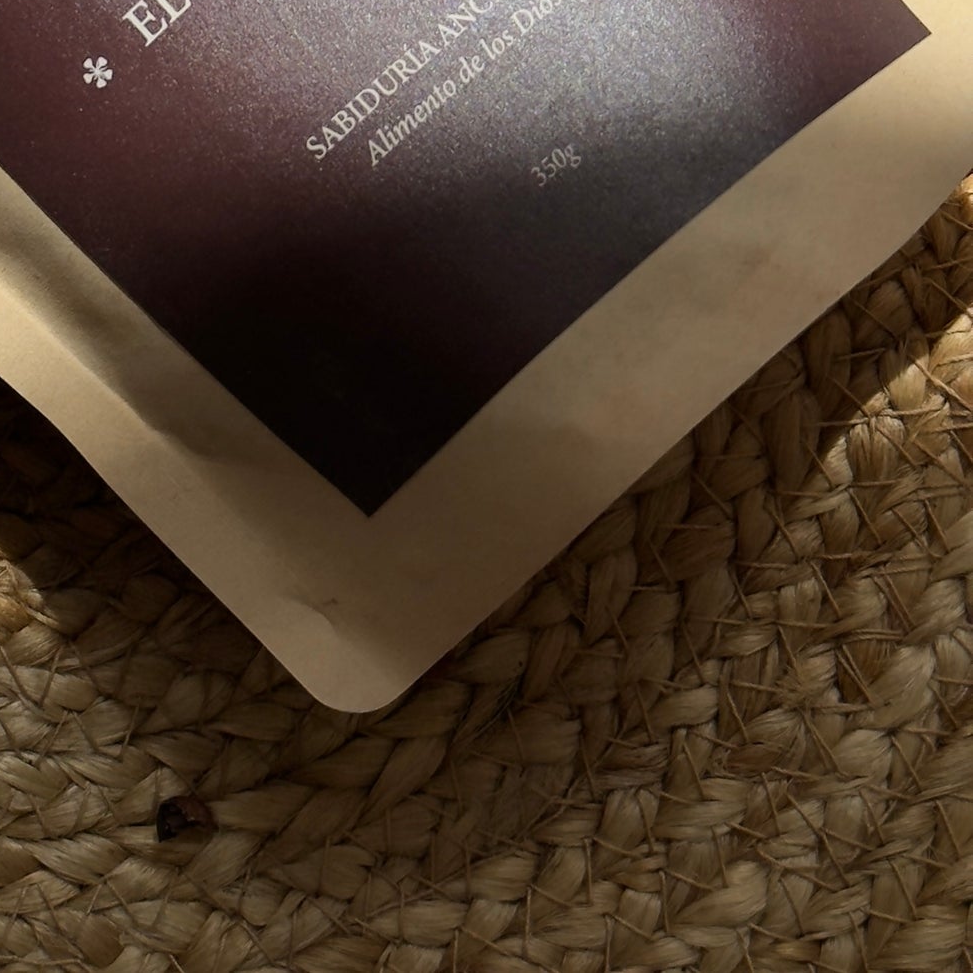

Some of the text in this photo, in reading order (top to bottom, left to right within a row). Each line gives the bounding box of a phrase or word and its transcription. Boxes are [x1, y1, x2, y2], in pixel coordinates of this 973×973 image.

[306, 37, 442, 160] SABIDURÍA
[366, 79, 458, 167] Alimento
[458, 55, 487, 85] de
[478, 31, 515, 60] los
[530, 142, 583, 188] 350g
